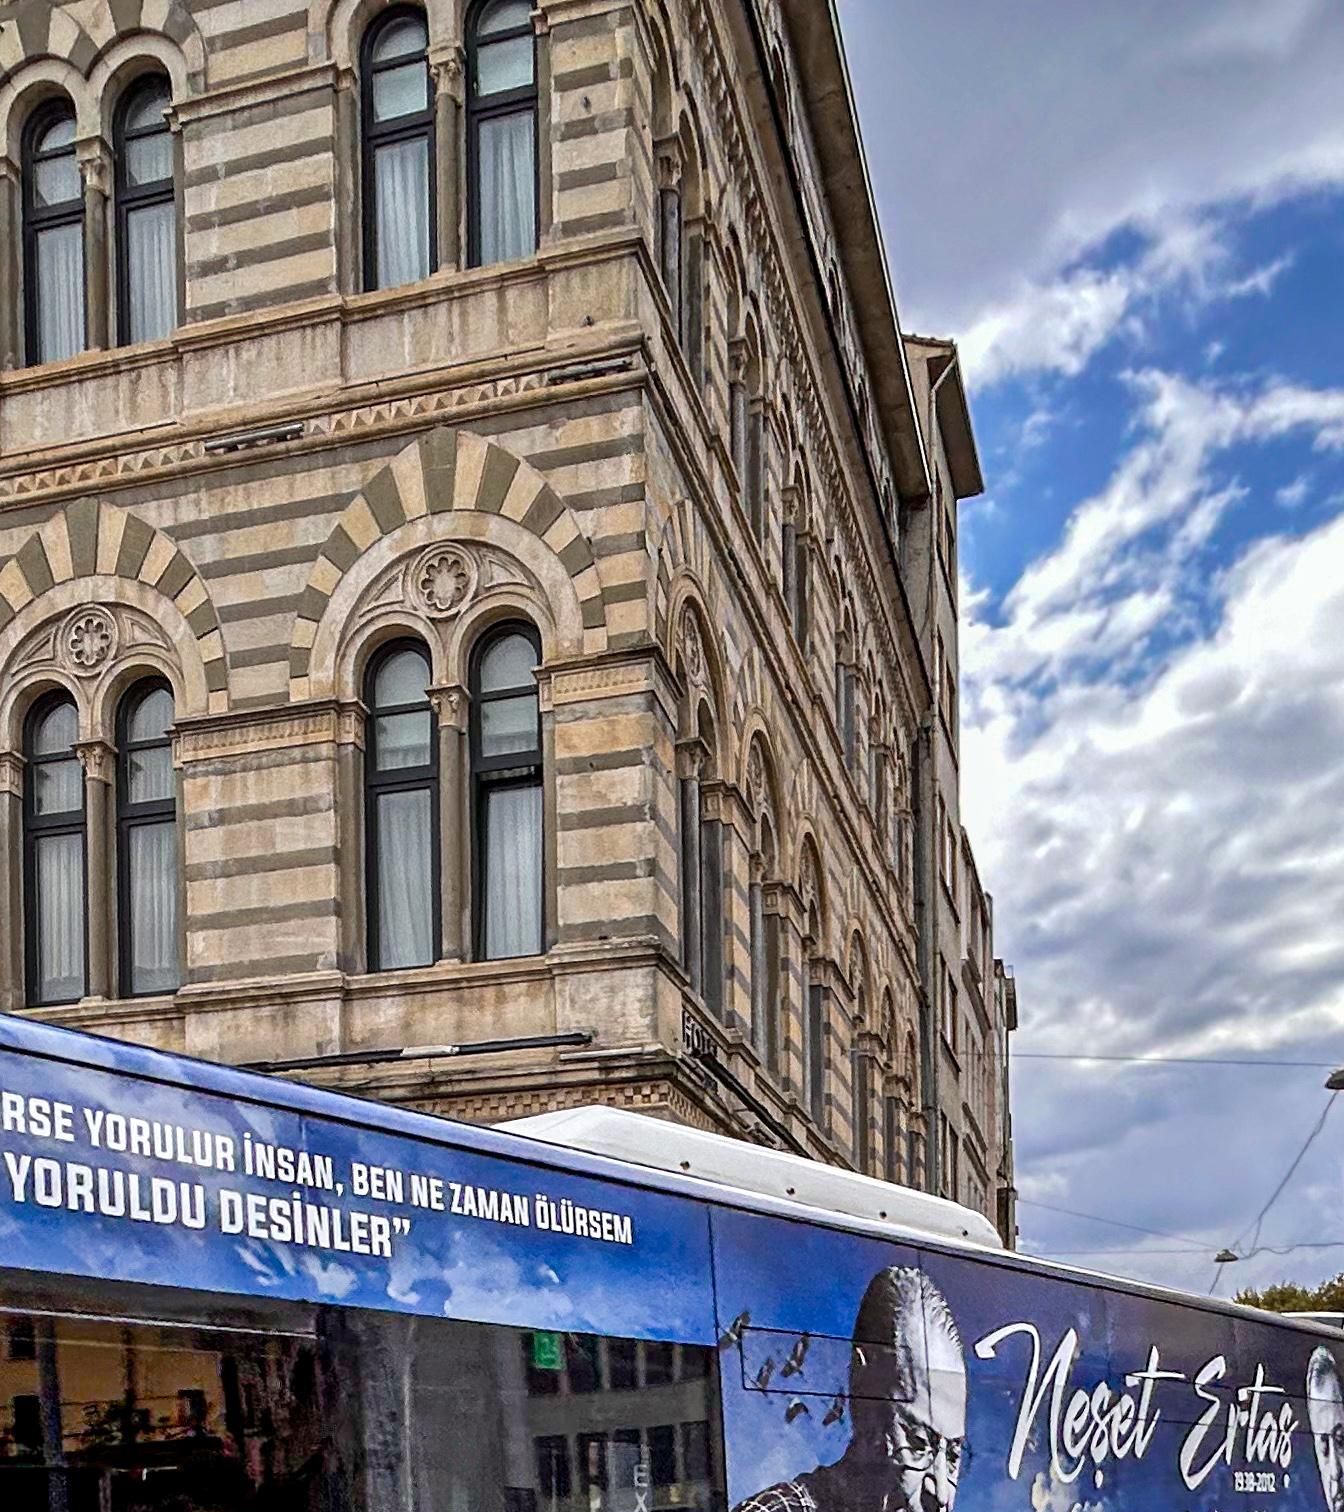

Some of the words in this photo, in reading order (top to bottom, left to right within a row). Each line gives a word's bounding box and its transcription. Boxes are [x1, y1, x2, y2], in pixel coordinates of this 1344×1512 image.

[2, 1151, 206, 1230] YORULDU
[82, 1107, 235, 1172] YORULUR
[244, 1132, 345, 1198] İNSAN,
[352, 1162, 405, 1203] BEN
[411, 1173, 445, 1211] NE
[449, 1182, 531, 1228] ZAMAN
[535, 1193, 633, 1246] ÖLÜRSEM
[974, 1321, 1186, 1489] Neşet
[1179, 1354, 1299, 1492] Ertaş
